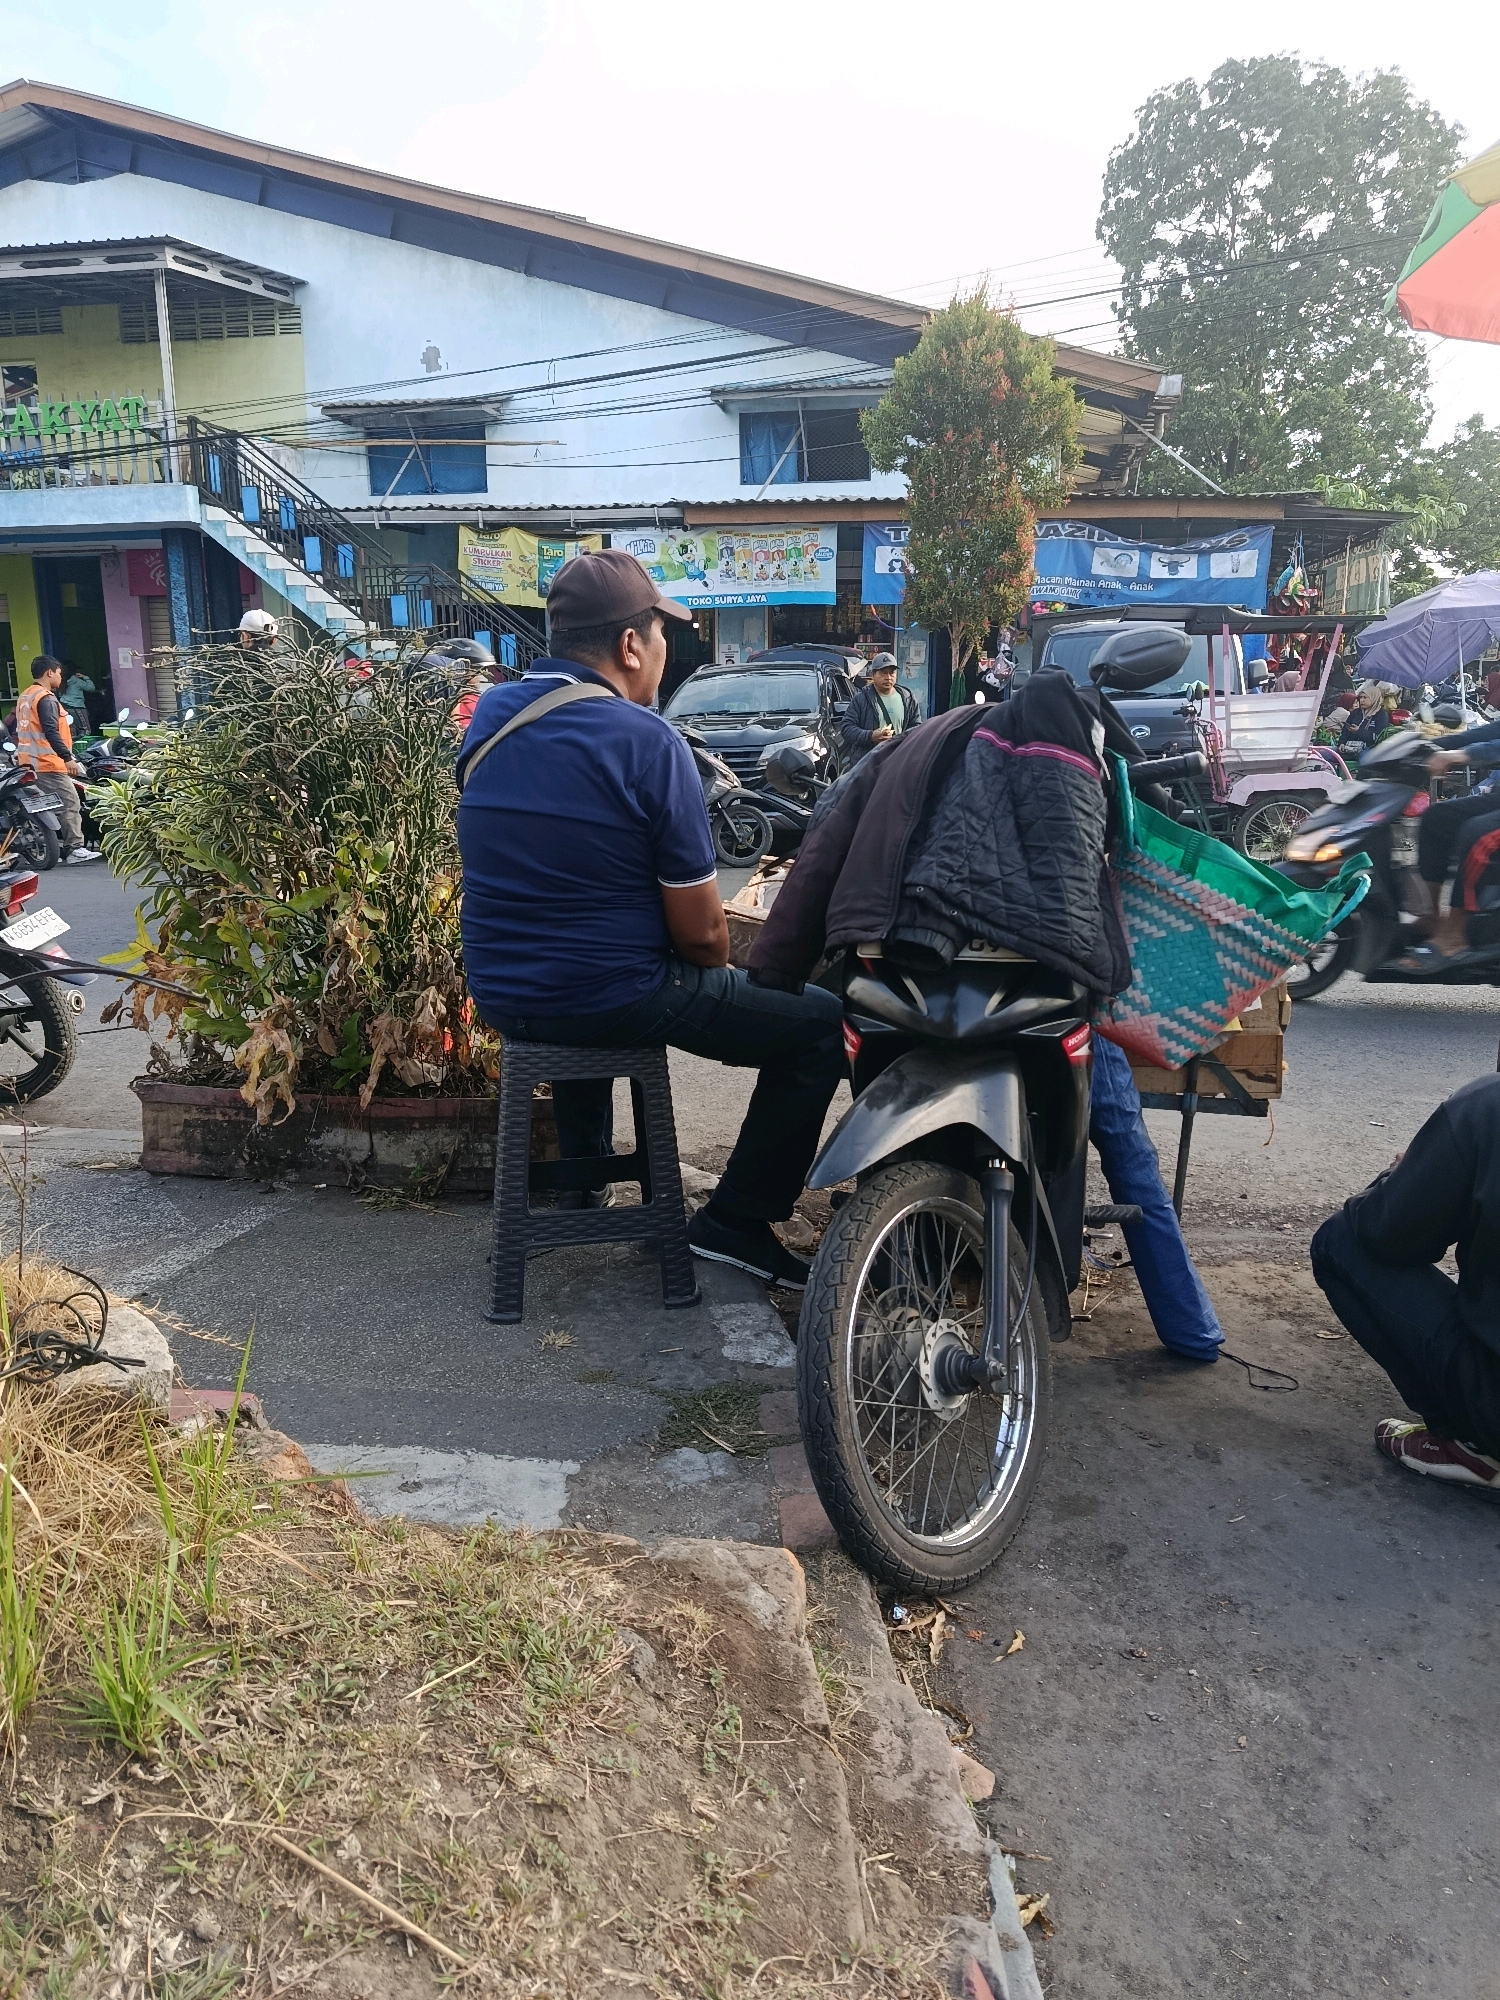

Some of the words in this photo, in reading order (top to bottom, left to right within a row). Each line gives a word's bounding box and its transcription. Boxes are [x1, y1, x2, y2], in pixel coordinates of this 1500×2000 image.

[0, 396, 148, 437] AKYAT
[463, 546, 512, 558] KUMPULKAN
[541, 545, 565, 557] Taro
[472, 557, 502, 567] STICKER
[1064, 576, 1096, 588] Mainan
[1098, 579, 1122, 589] Anak
[1129, 581, 1154, 591] Anak
[687, 597, 713, 606] TOKO
[714, 595, 744, 605] SURYA
[745, 594, 768, 603] JAYA
